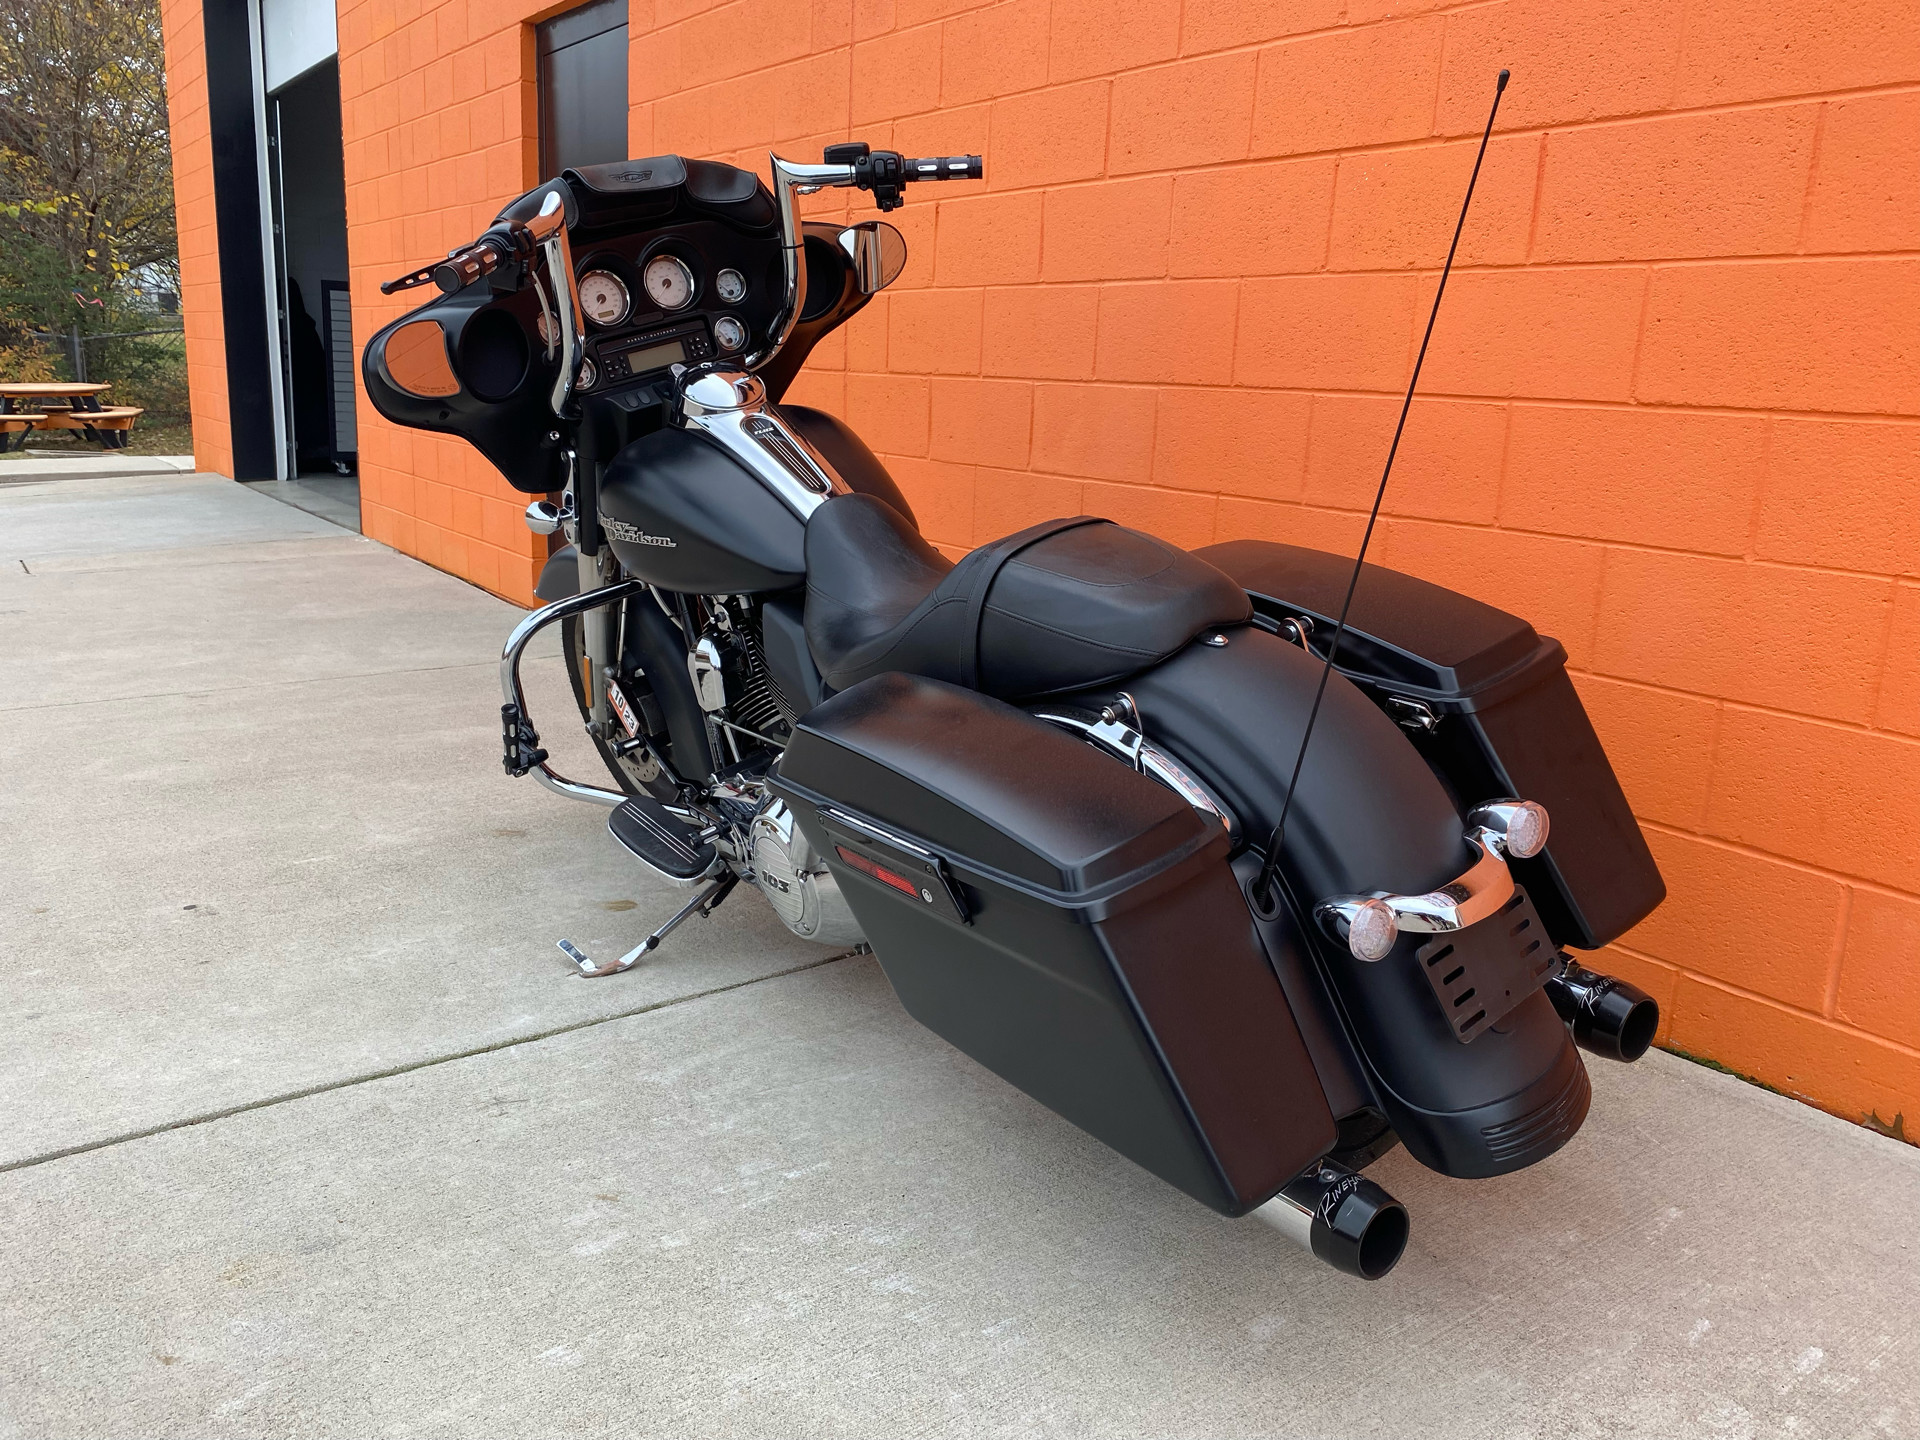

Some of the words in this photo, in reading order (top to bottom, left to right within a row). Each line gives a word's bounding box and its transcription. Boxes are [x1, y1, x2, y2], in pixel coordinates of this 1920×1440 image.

[605, 525, 677, 548] Davidson
[614, 689, 624, 709] 10
[623, 711, 635, 730] 23
[761, 869, 791, 893] 103
